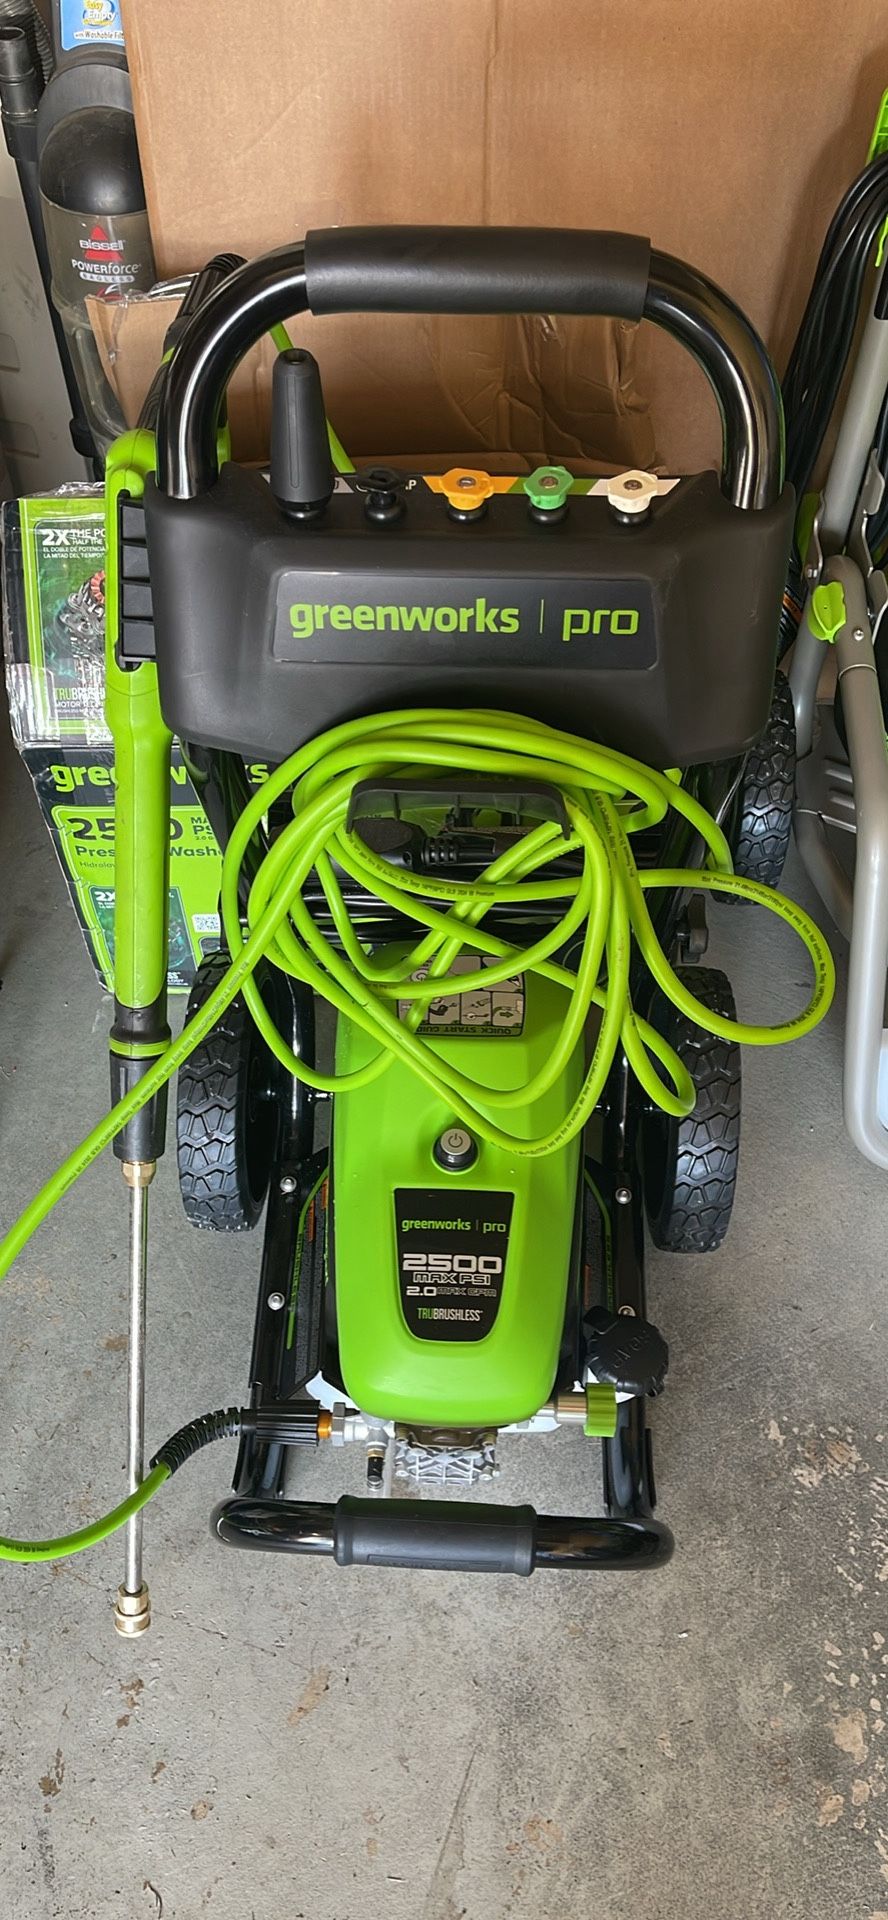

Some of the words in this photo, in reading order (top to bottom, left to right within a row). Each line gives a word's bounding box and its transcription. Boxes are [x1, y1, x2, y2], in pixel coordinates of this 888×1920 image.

[289, 597, 520, 639] greenworks
[562, 608, 640, 642] pro
[443, 1026, 479, 1035] START
[480, 1027, 512, 1035] QUICK
[401, 1218, 472, 1232] greenworks
[482, 1221, 507, 1234] pro
[402, 1253, 503, 1274] 2500
[412, 1271, 458, 1285] MAX
[458, 1273, 491, 1286] PSI
